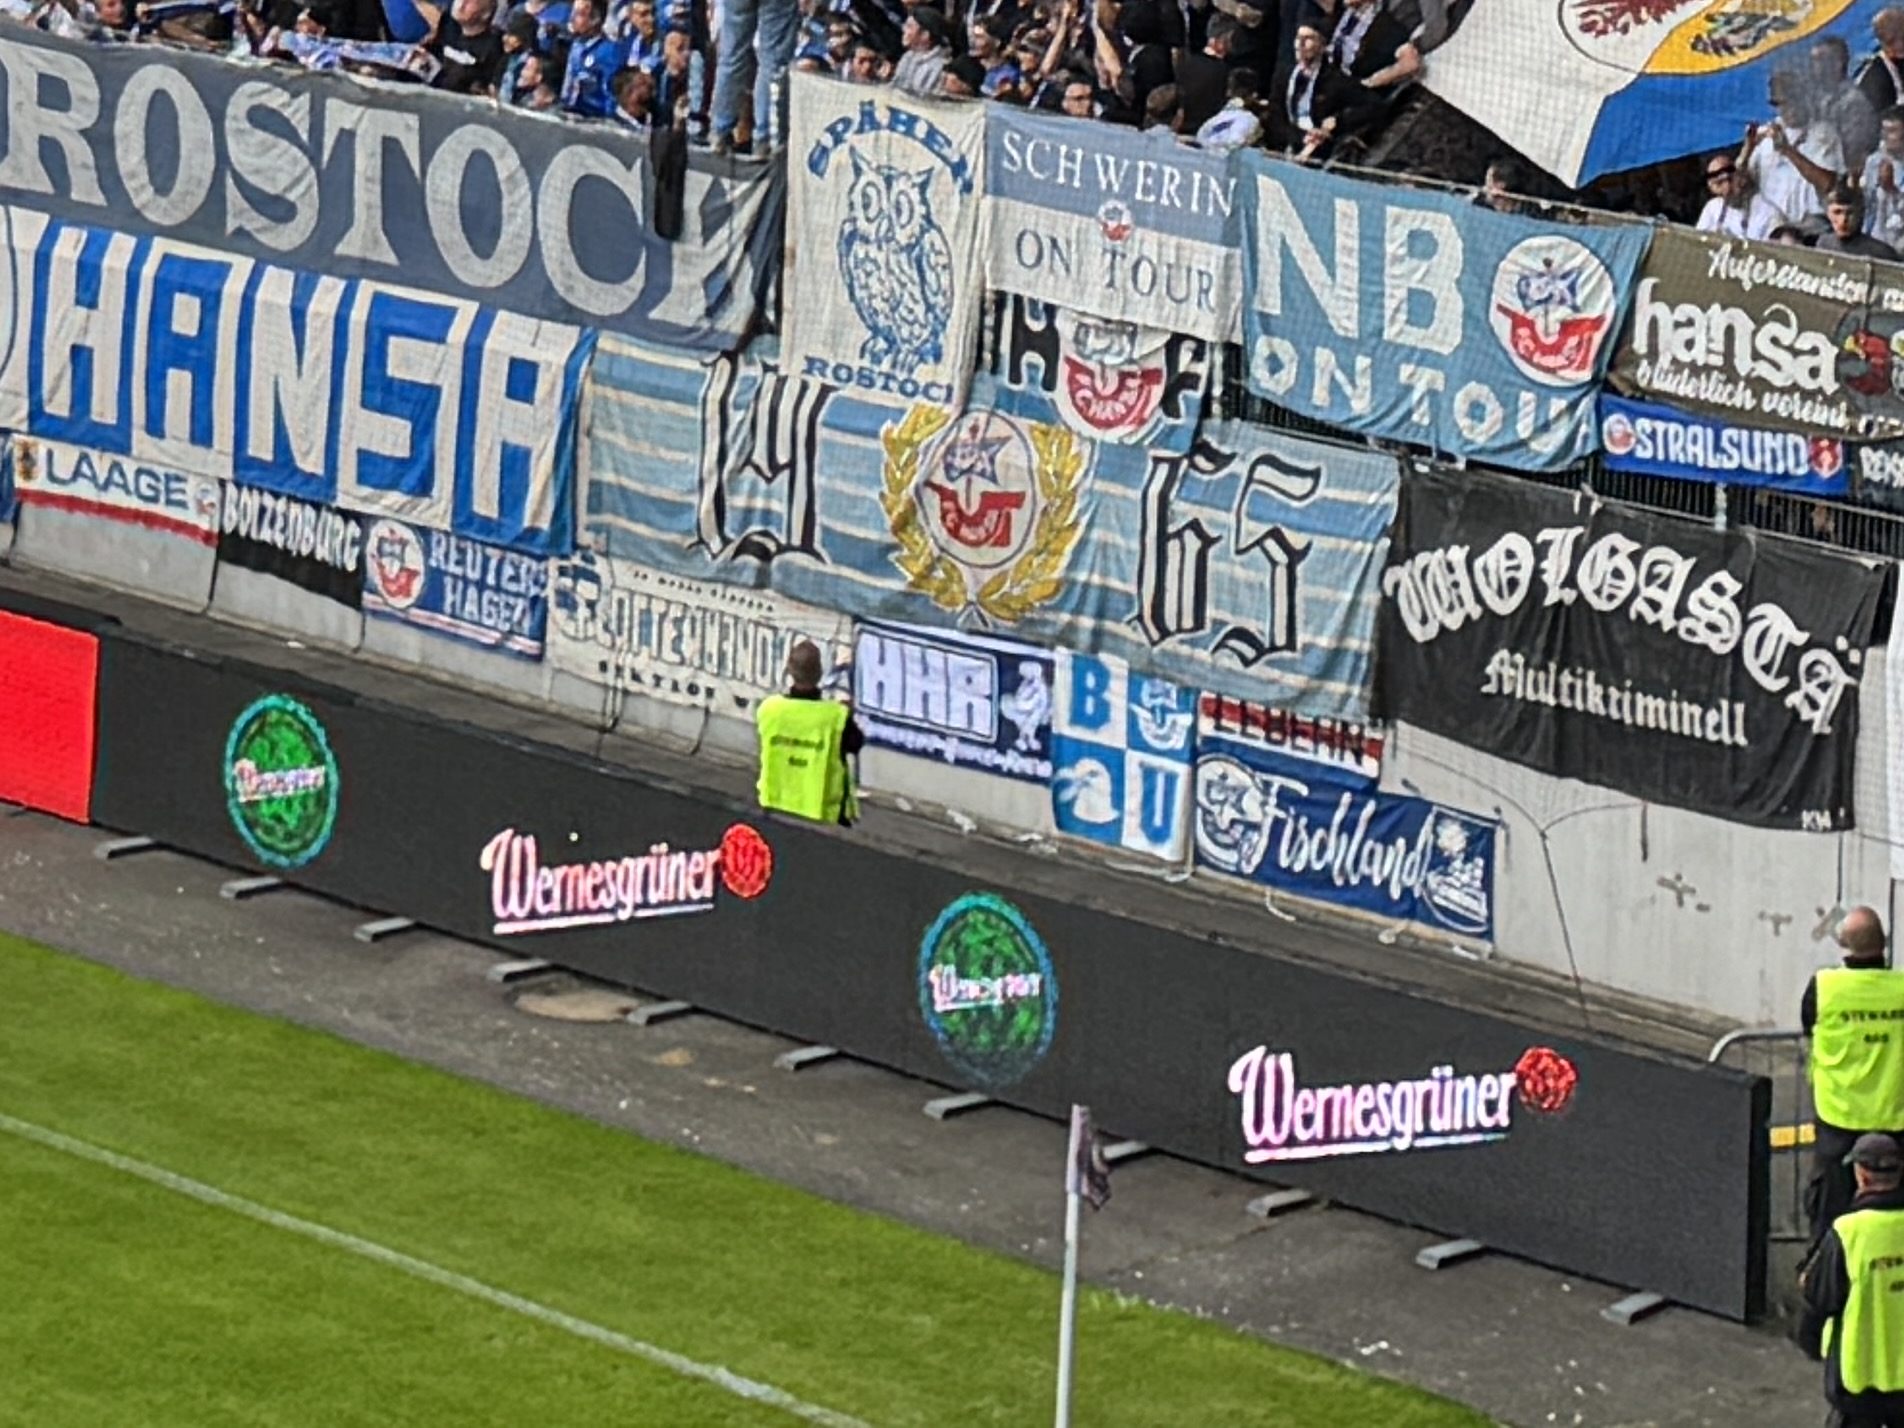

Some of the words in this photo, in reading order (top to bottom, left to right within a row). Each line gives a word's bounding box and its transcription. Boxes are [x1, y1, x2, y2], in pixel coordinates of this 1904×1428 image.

[1002, 131, 1237, 217] SCHWERIN
[1015, 229, 1073, 277] ON
[1101, 248, 1216, 313] TOUR
[1254, 172, 1464, 356] NB
[804, 355, 953, 403] ROSTOC
[1250, 334, 1372, 416] ON
[1632, 276, 1842, 395] hansa
[34, 224, 584, 542] HANSA
[46, 446, 191, 511] LAAGE
[1635, 416, 1809, 477] STRALSUND
[222, 482, 361, 572] BOIZENBURG
[1481, 647, 1748, 746] Multikriminell
[480, 828, 721, 921] Wernesgrüner
[1238, 770, 1436, 901] Fischland
[1228, 1045, 1518, 1150] Wernesgrüner
